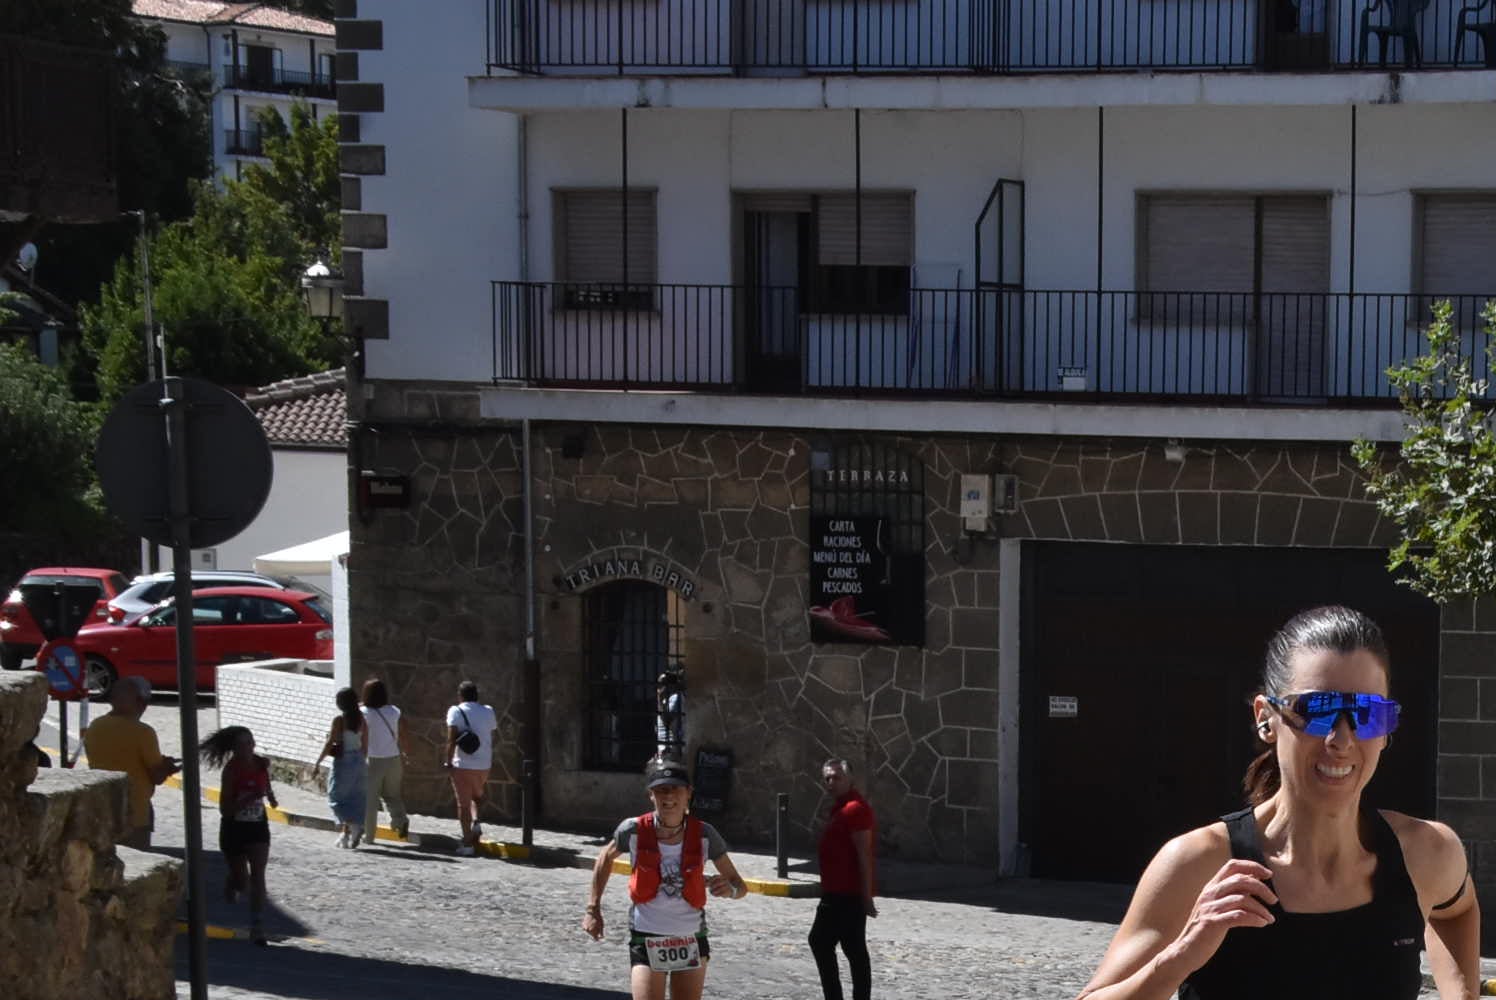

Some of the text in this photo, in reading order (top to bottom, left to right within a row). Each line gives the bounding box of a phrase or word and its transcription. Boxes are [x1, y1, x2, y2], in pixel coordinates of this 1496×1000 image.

[826, 470, 909, 482] TERRAZA
[829, 520, 855, 532] CARTA
[823, 536, 862, 548] RACIONES
[813, 549, 871, 563] MENÚ DEL DÍA
[566, 560, 694, 596] TRIANA BAR
[827, 567, 858, 579] CARNES
[823, 582, 862, 593] PESCADOS
[658, 947, 688, 962] 300
